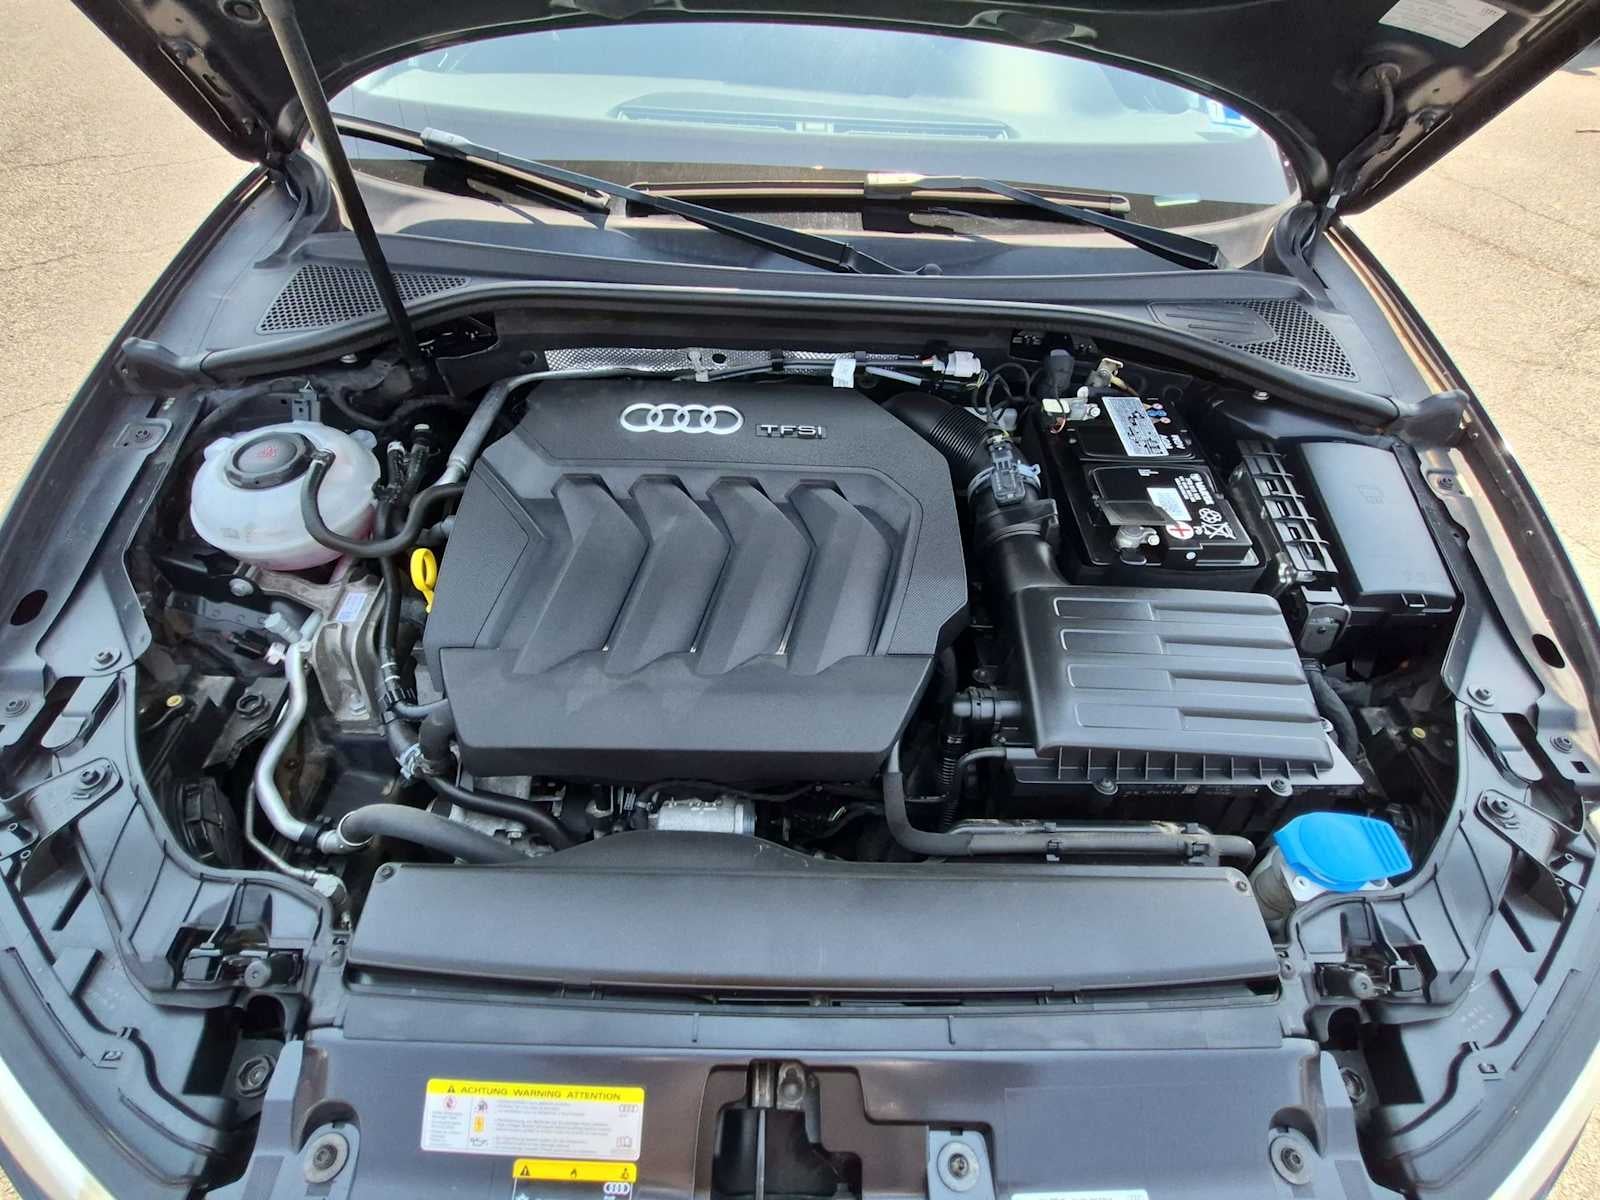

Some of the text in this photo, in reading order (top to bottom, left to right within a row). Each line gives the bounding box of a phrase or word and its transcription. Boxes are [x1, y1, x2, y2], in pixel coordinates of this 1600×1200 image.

[760, 424, 822, 436] TFSI
[460, 1085, 622, 1101] ACHTUNG WARNING ATTENTION
